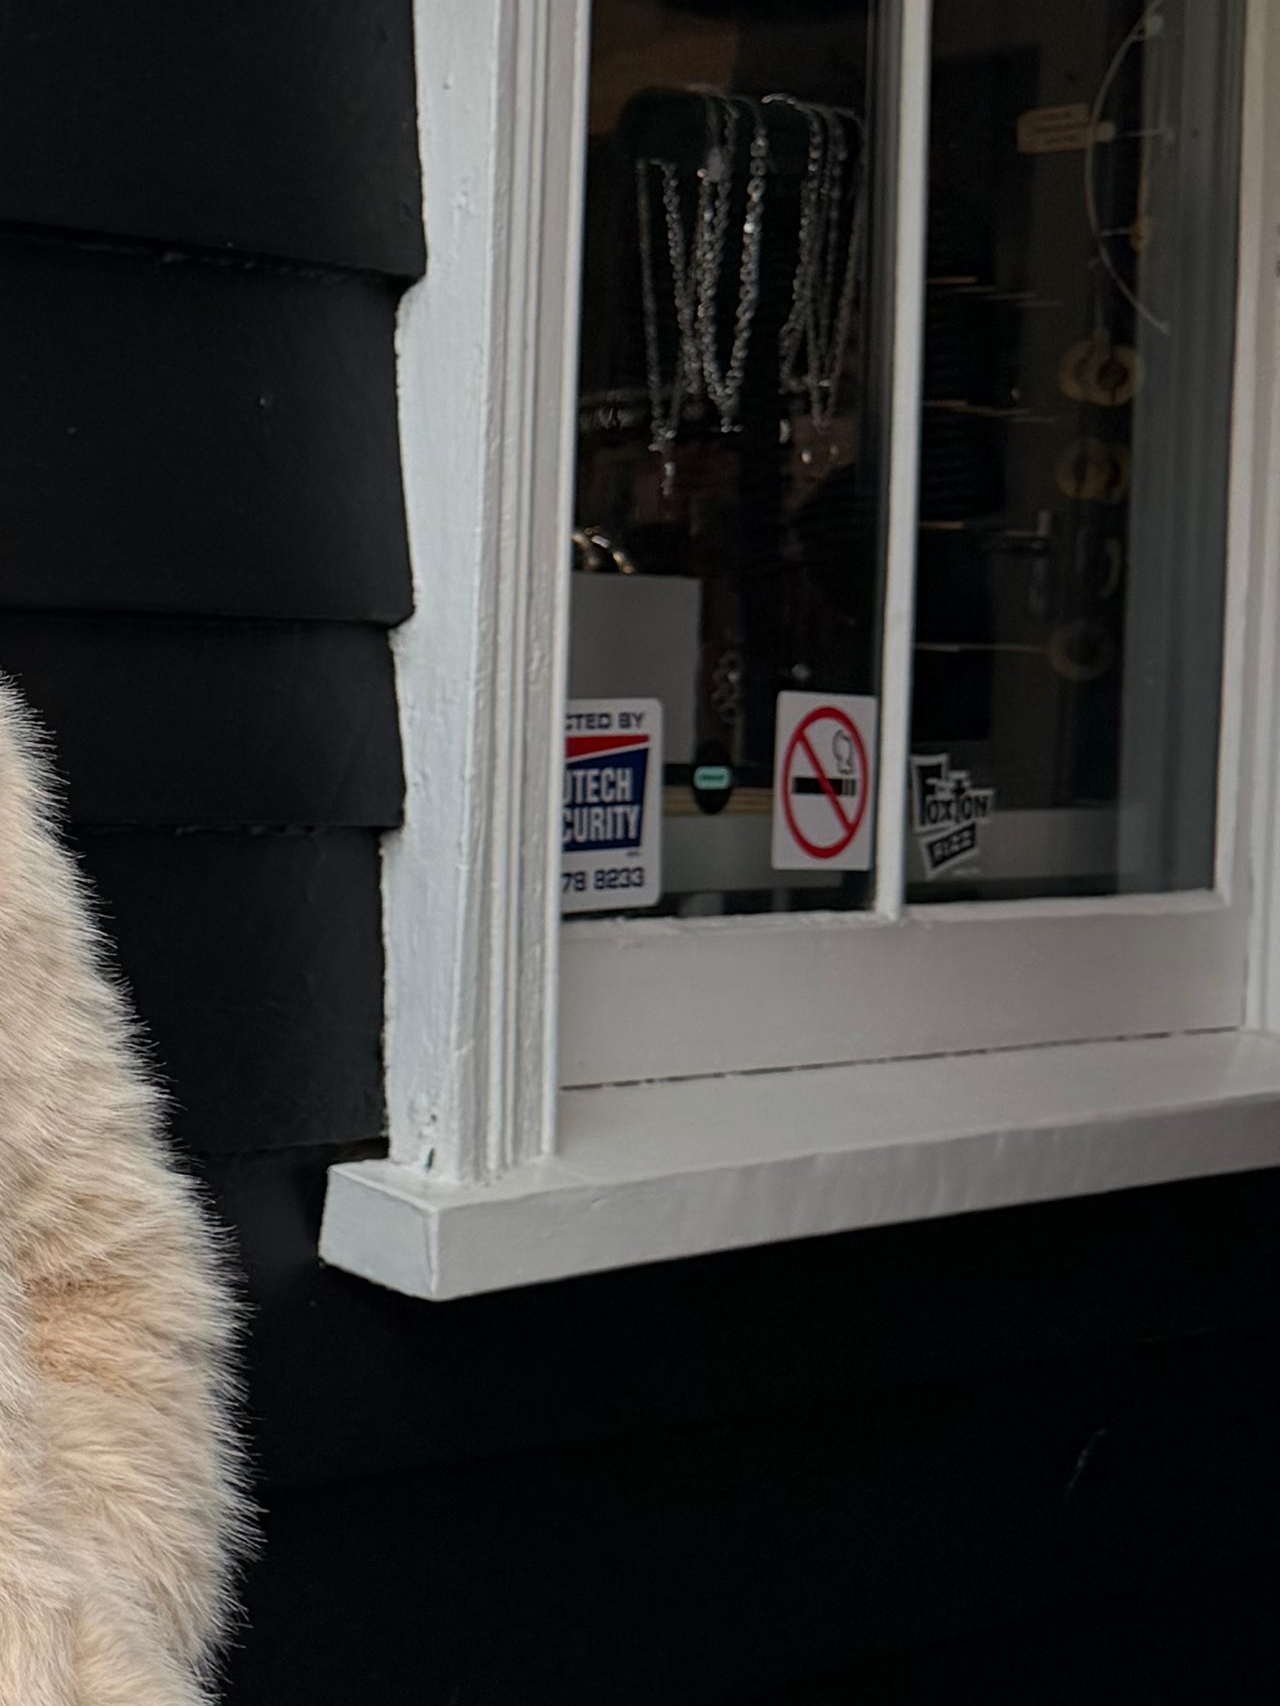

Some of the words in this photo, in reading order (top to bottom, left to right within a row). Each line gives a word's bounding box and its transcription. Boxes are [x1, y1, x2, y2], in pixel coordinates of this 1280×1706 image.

[618, 711, 645, 730] BY
[562, 767, 634, 806] UTECH
[561, 804, 641, 843] CURITY
[561, 870, 587, 893] 78
[594, 867, 645, 891] 8233
